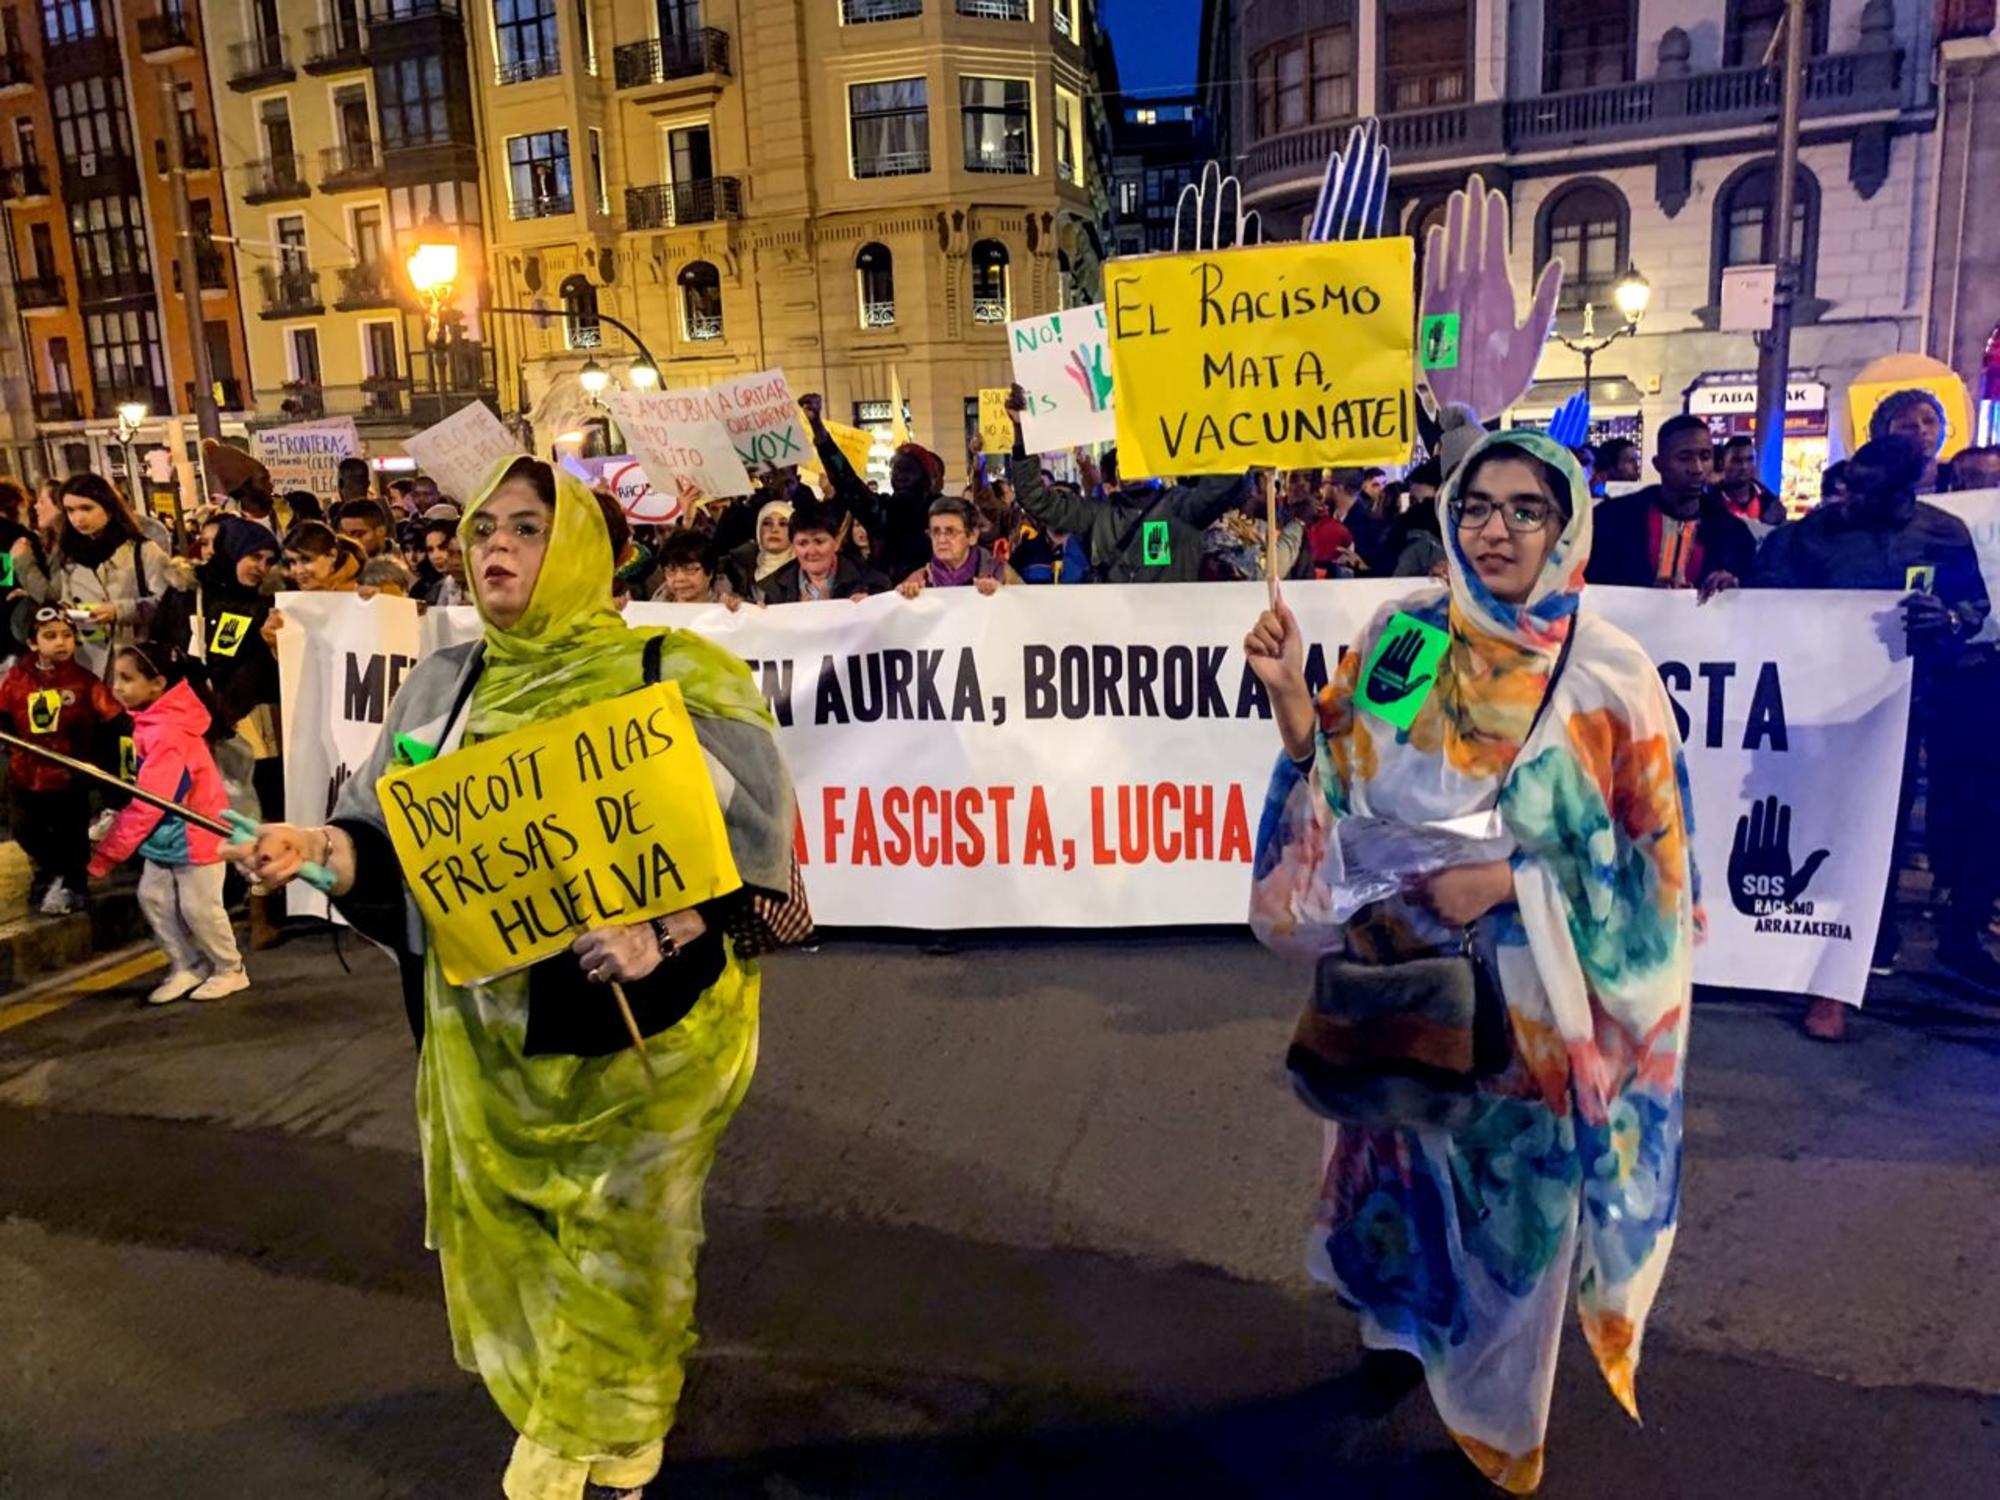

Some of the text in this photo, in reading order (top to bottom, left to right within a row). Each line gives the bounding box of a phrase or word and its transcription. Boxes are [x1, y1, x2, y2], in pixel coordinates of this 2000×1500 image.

[1014, 315, 1063, 352] NO!
[1114, 275, 1170, 339] EL
[1203, 350, 1333, 392] MATA,
[734, 425, 801, 464] VOX
[343, 650, 418, 725] ME
[813, 645, 1007, 729] AURKA,
[1022, 643, 1273, 720] BORROKA
[389, 744, 547, 851] BOYCOTT
[822, 784, 1076, 872] FASCISTA,
[1091, 781, 1254, 864] LUCHA
[419, 788, 656, 915] FRESAS DE
[489, 842, 686, 956] HUELVA
[1742, 873, 1785, 897] SOS
[1754, 917, 1853, 942] ARRAZAKERIA
